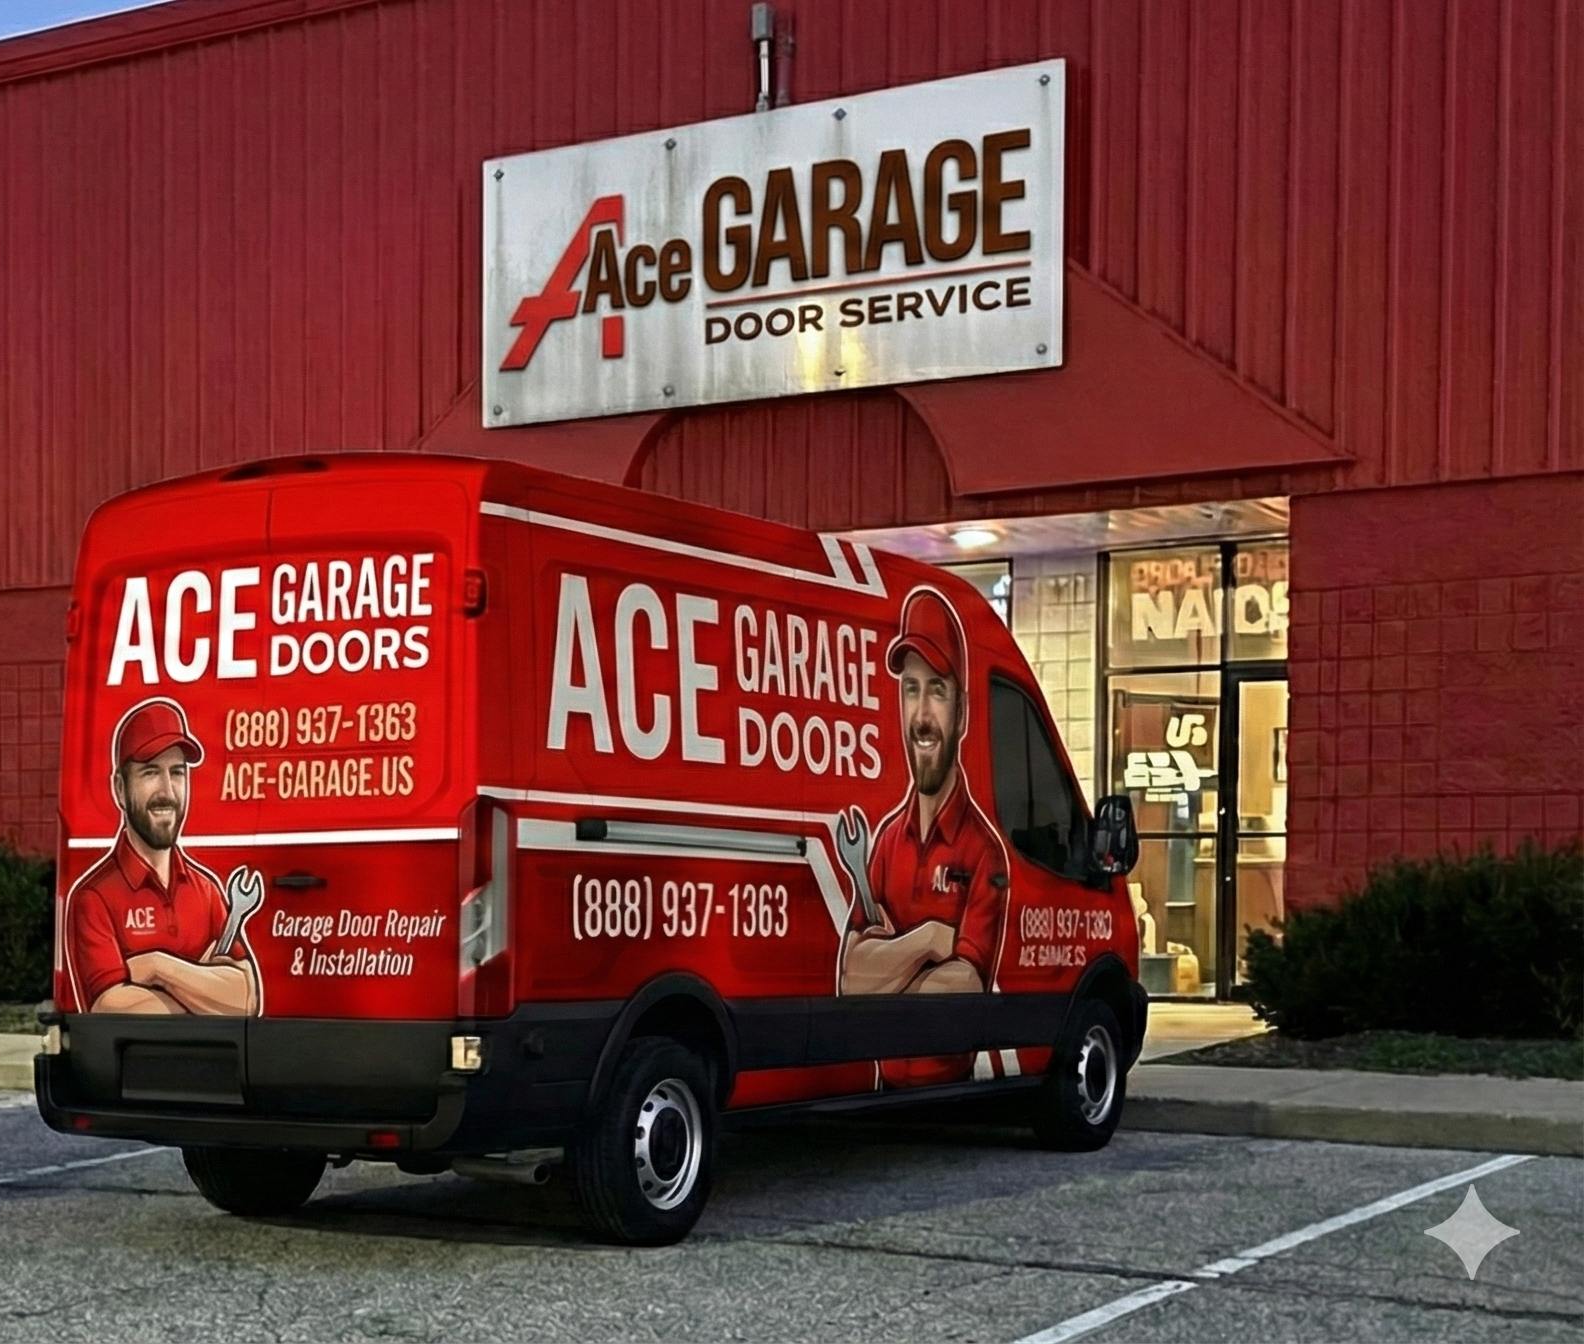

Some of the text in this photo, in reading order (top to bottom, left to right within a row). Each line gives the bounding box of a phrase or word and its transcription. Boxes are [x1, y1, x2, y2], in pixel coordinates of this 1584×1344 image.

[581, 128, 1031, 314] Ace GARAGE
[705, 277, 1031, 344] DOOR SERVICE
[107, 553, 433, 685] ACE GARAGE
[270, 626, 428, 675] DOORS
[547, 573, 879, 764] ACE GARAGE
[226, 702, 416, 750] (888) 937-1363
[739, 707, 881, 779] DOORS
[221, 756, 413, 800] ACE-GARAGE.US
[126, 907, 155, 928] ACE
[272, 910, 446, 943] Garage Door Repair
[573, 874, 788, 940] (888) 937-1363
[291, 946, 413, 975] & Installation
